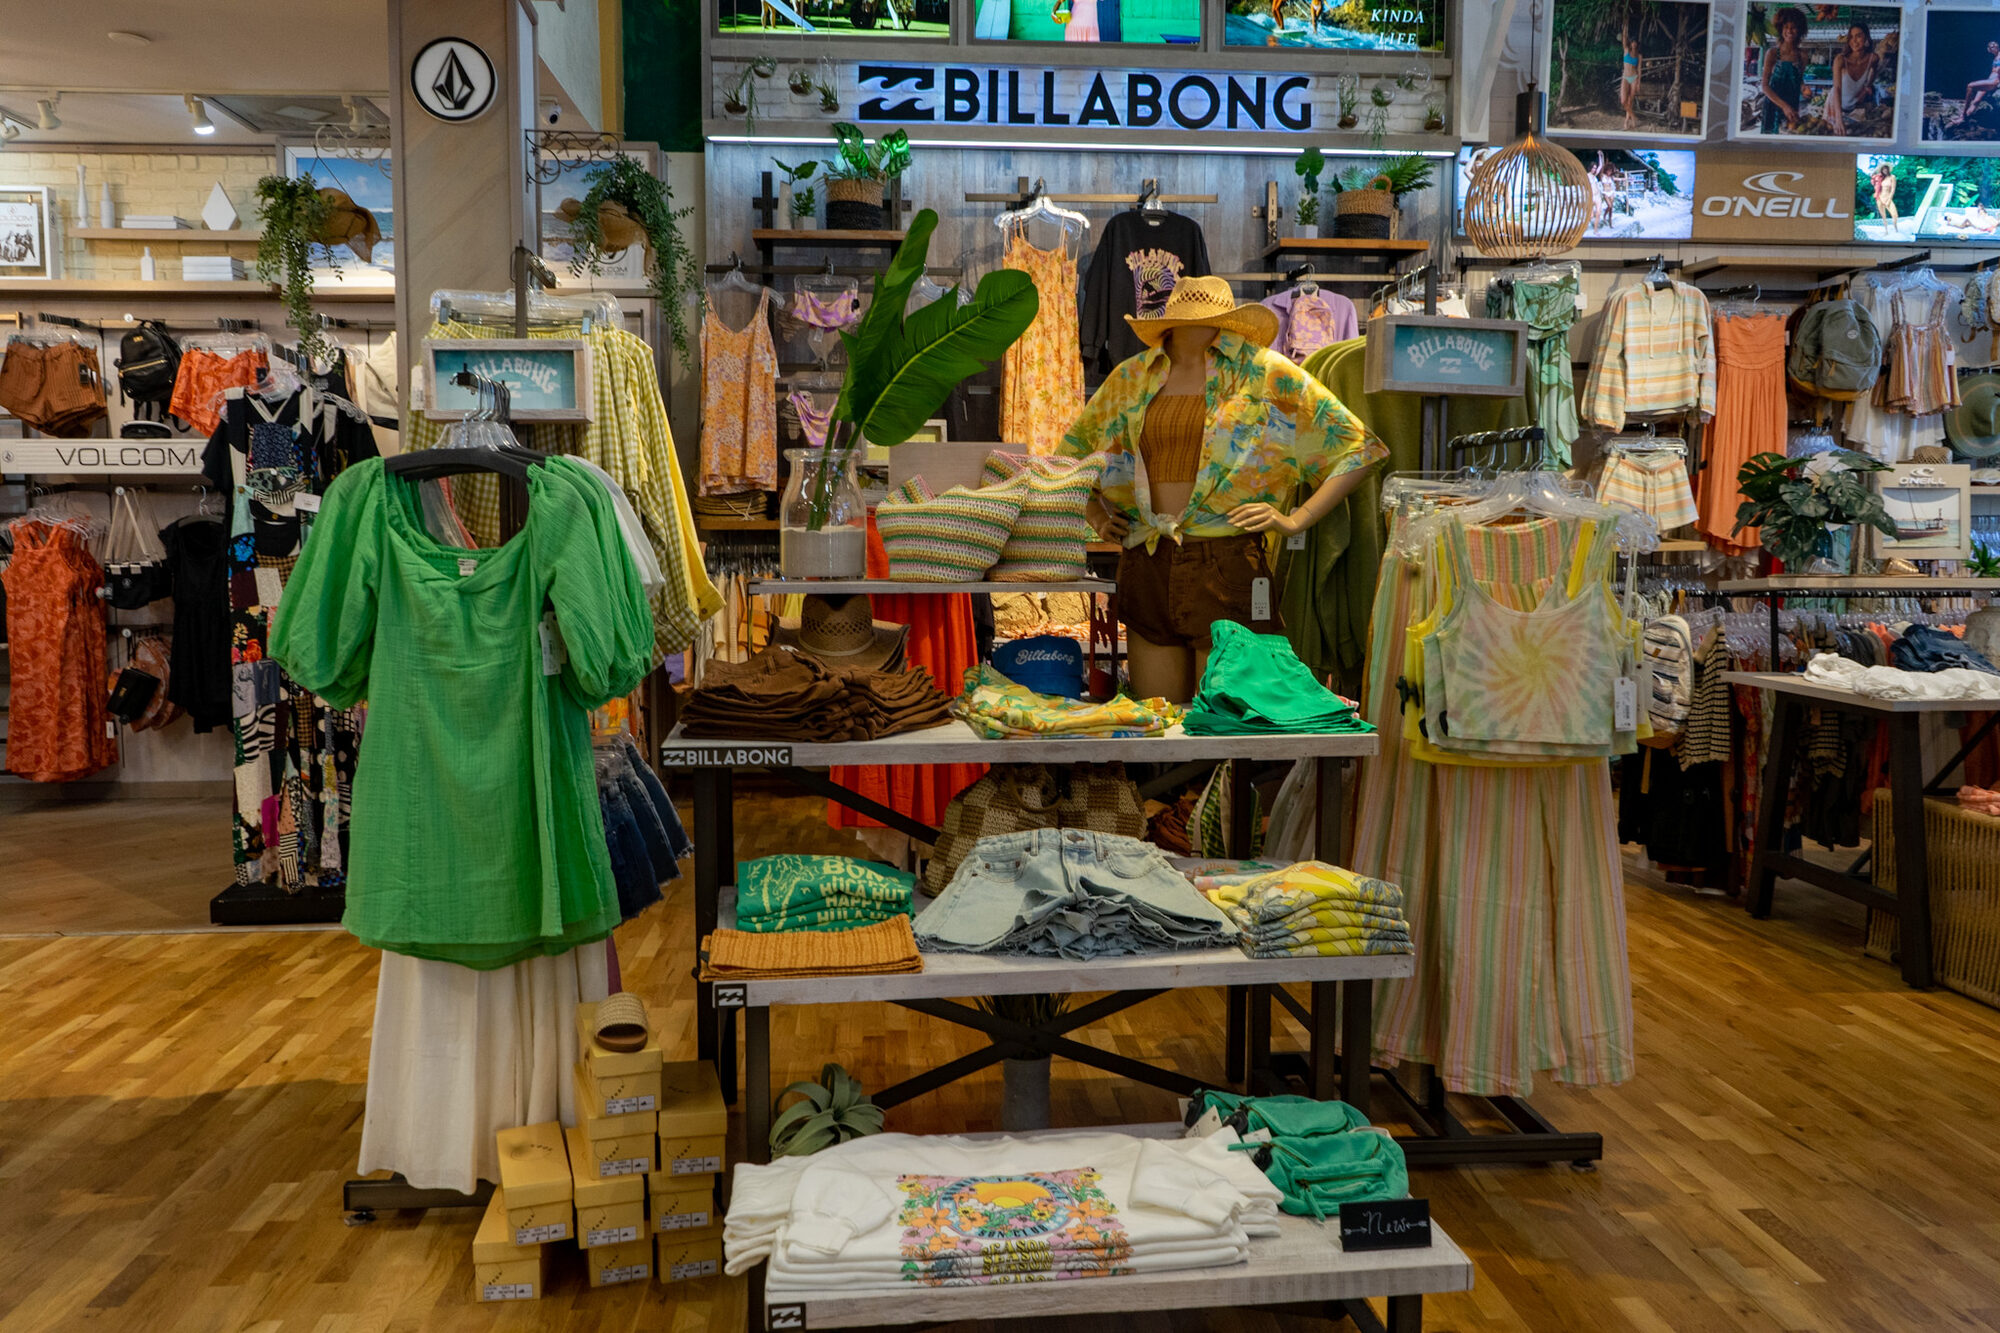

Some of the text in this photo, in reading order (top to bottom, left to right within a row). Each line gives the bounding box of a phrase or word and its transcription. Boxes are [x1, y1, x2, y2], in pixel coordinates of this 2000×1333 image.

[1370, 8, 1425, 24] KINDA
[1378, 31, 1417, 46] LIFE
[944, 68, 1312, 131] BILLABONG
[1701, 195, 1850, 219] O'NEILL
[1407, 335, 1496, 371] BILLABONG
[472, 356, 561, 394] ILLABONG
[55, 447, 196, 466] VOLCOM
[1015, 649, 1075, 666] Billabong
[686, 749, 789, 766] BILLABONG
[871, 885, 908, 901] HUT
[1362, 1211, 1407, 1235] New
